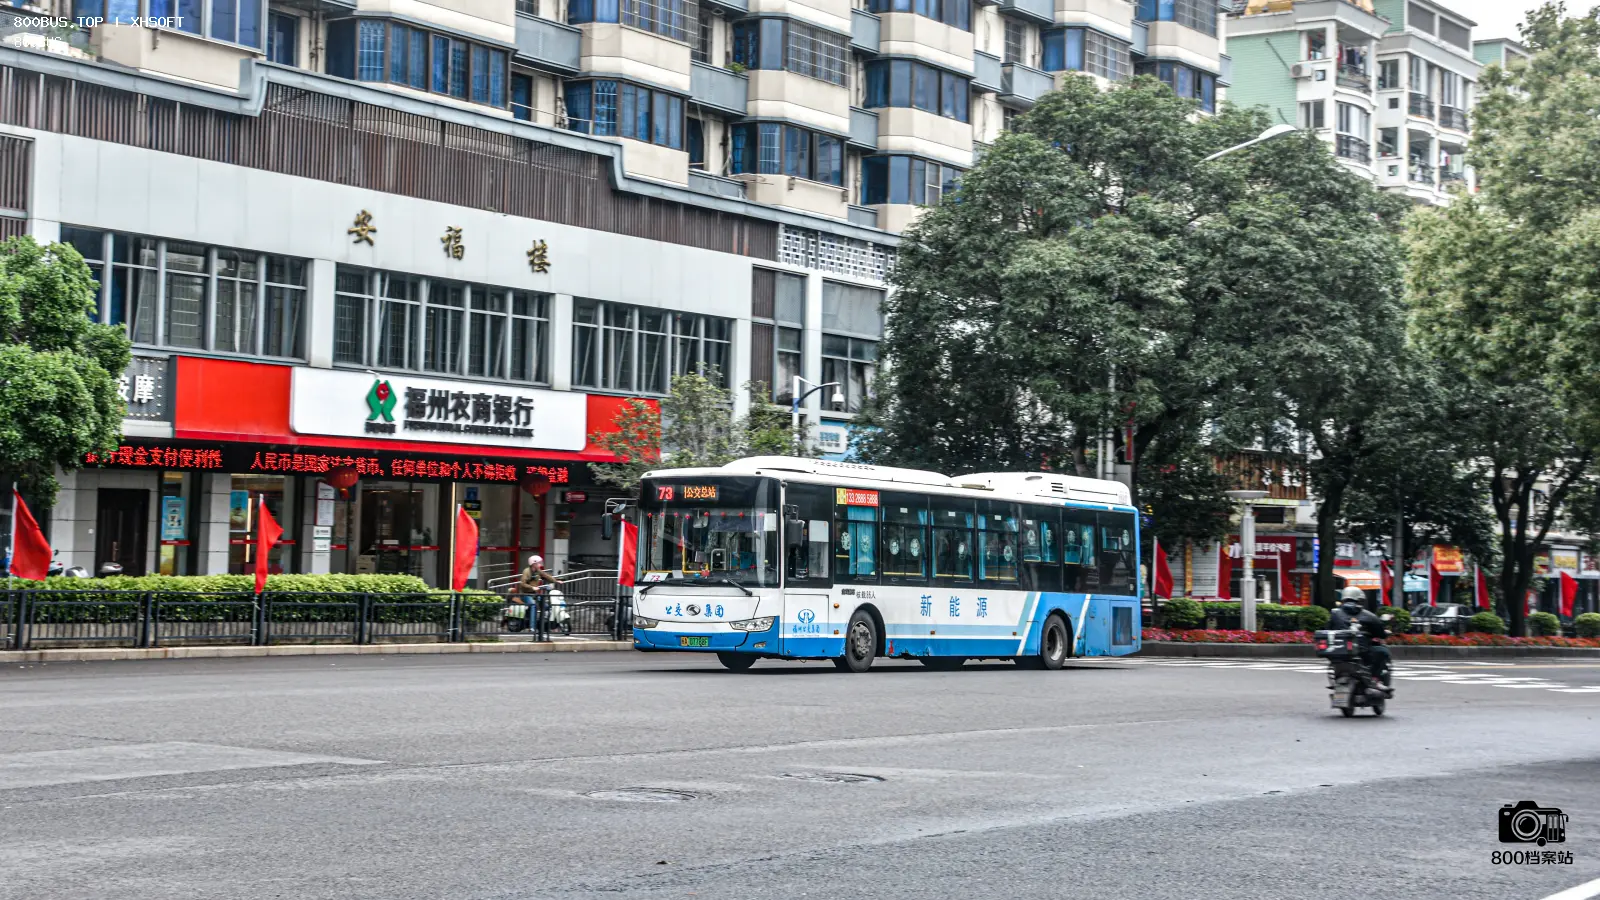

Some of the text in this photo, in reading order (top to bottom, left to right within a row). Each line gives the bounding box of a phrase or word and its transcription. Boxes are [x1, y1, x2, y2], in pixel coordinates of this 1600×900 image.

[348, 209, 551, 274] 安福楼
[404, 386, 534, 426] 福州农商银行
[658, 486, 675, 500] 73
[665, 603, 724, 618] 公交 集团
[920, 594, 988, 618] 新能源
